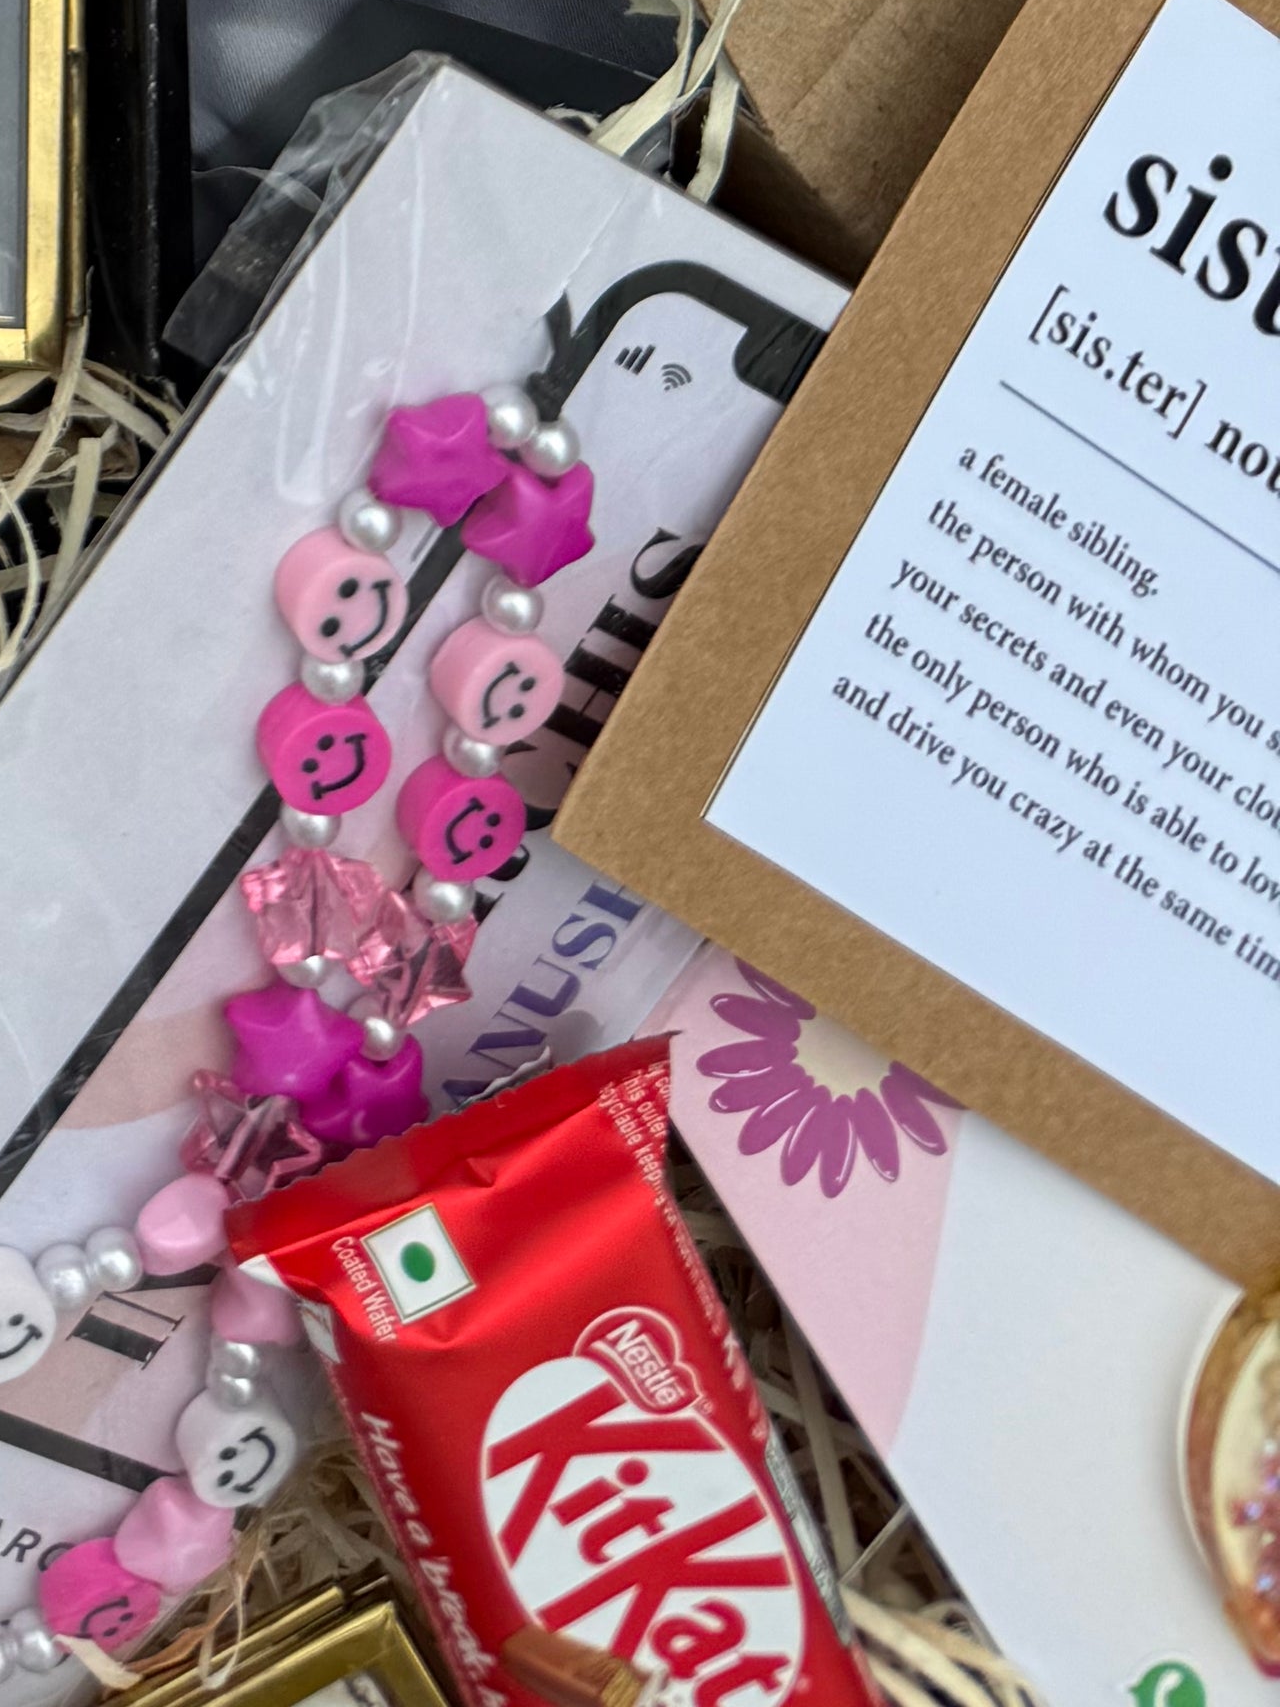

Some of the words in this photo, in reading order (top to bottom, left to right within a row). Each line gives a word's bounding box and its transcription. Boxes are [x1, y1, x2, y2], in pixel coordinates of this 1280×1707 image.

[1028, 284, 1207, 439] [sis.ter]
[928, 500, 973, 544] the
[968, 534, 1062, 605] person
[1067, 595, 1125, 648] with
[1130, 637, 1210, 704] whom
[1209, 694, 1264, 739] you
[959, 448, 977, 471] a
[979, 454, 1068, 529] female
[1068, 521, 1159, 598] sibling.
[865, 614, 909, 658] the
[911, 649, 972, 703] only
[966, 688, 1061, 759] person
[1066, 748, 1121, 796] who
[1123, 781, 1149, 815] is
[1150, 805, 1208, 853] able
[1209, 840, 1239, 874] to
[890, 560, 960, 612] your
[959, 603, 1048, 672] secrets
[1049, 663, 1108, 708] and
[1104, 700, 1165, 751] even
[1162, 740, 1233, 792] your
[832, 676, 891, 721] and
[887, 706, 956, 765] drive
[951, 756, 1008, 800] you
[1009, 792, 1083, 853] crazy
[1082, 840, 1113, 868] at
[1114, 855, 1160, 898] the
[1160, 890, 1233, 945] same
[331, 1235, 377, 1297] Coated
[360, 1288, 397, 1345] Wafer
[360, 1410, 420, 1517] Have
[406, 1517, 434, 1549] a
[486, 1379, 796, 1707] KitKat
